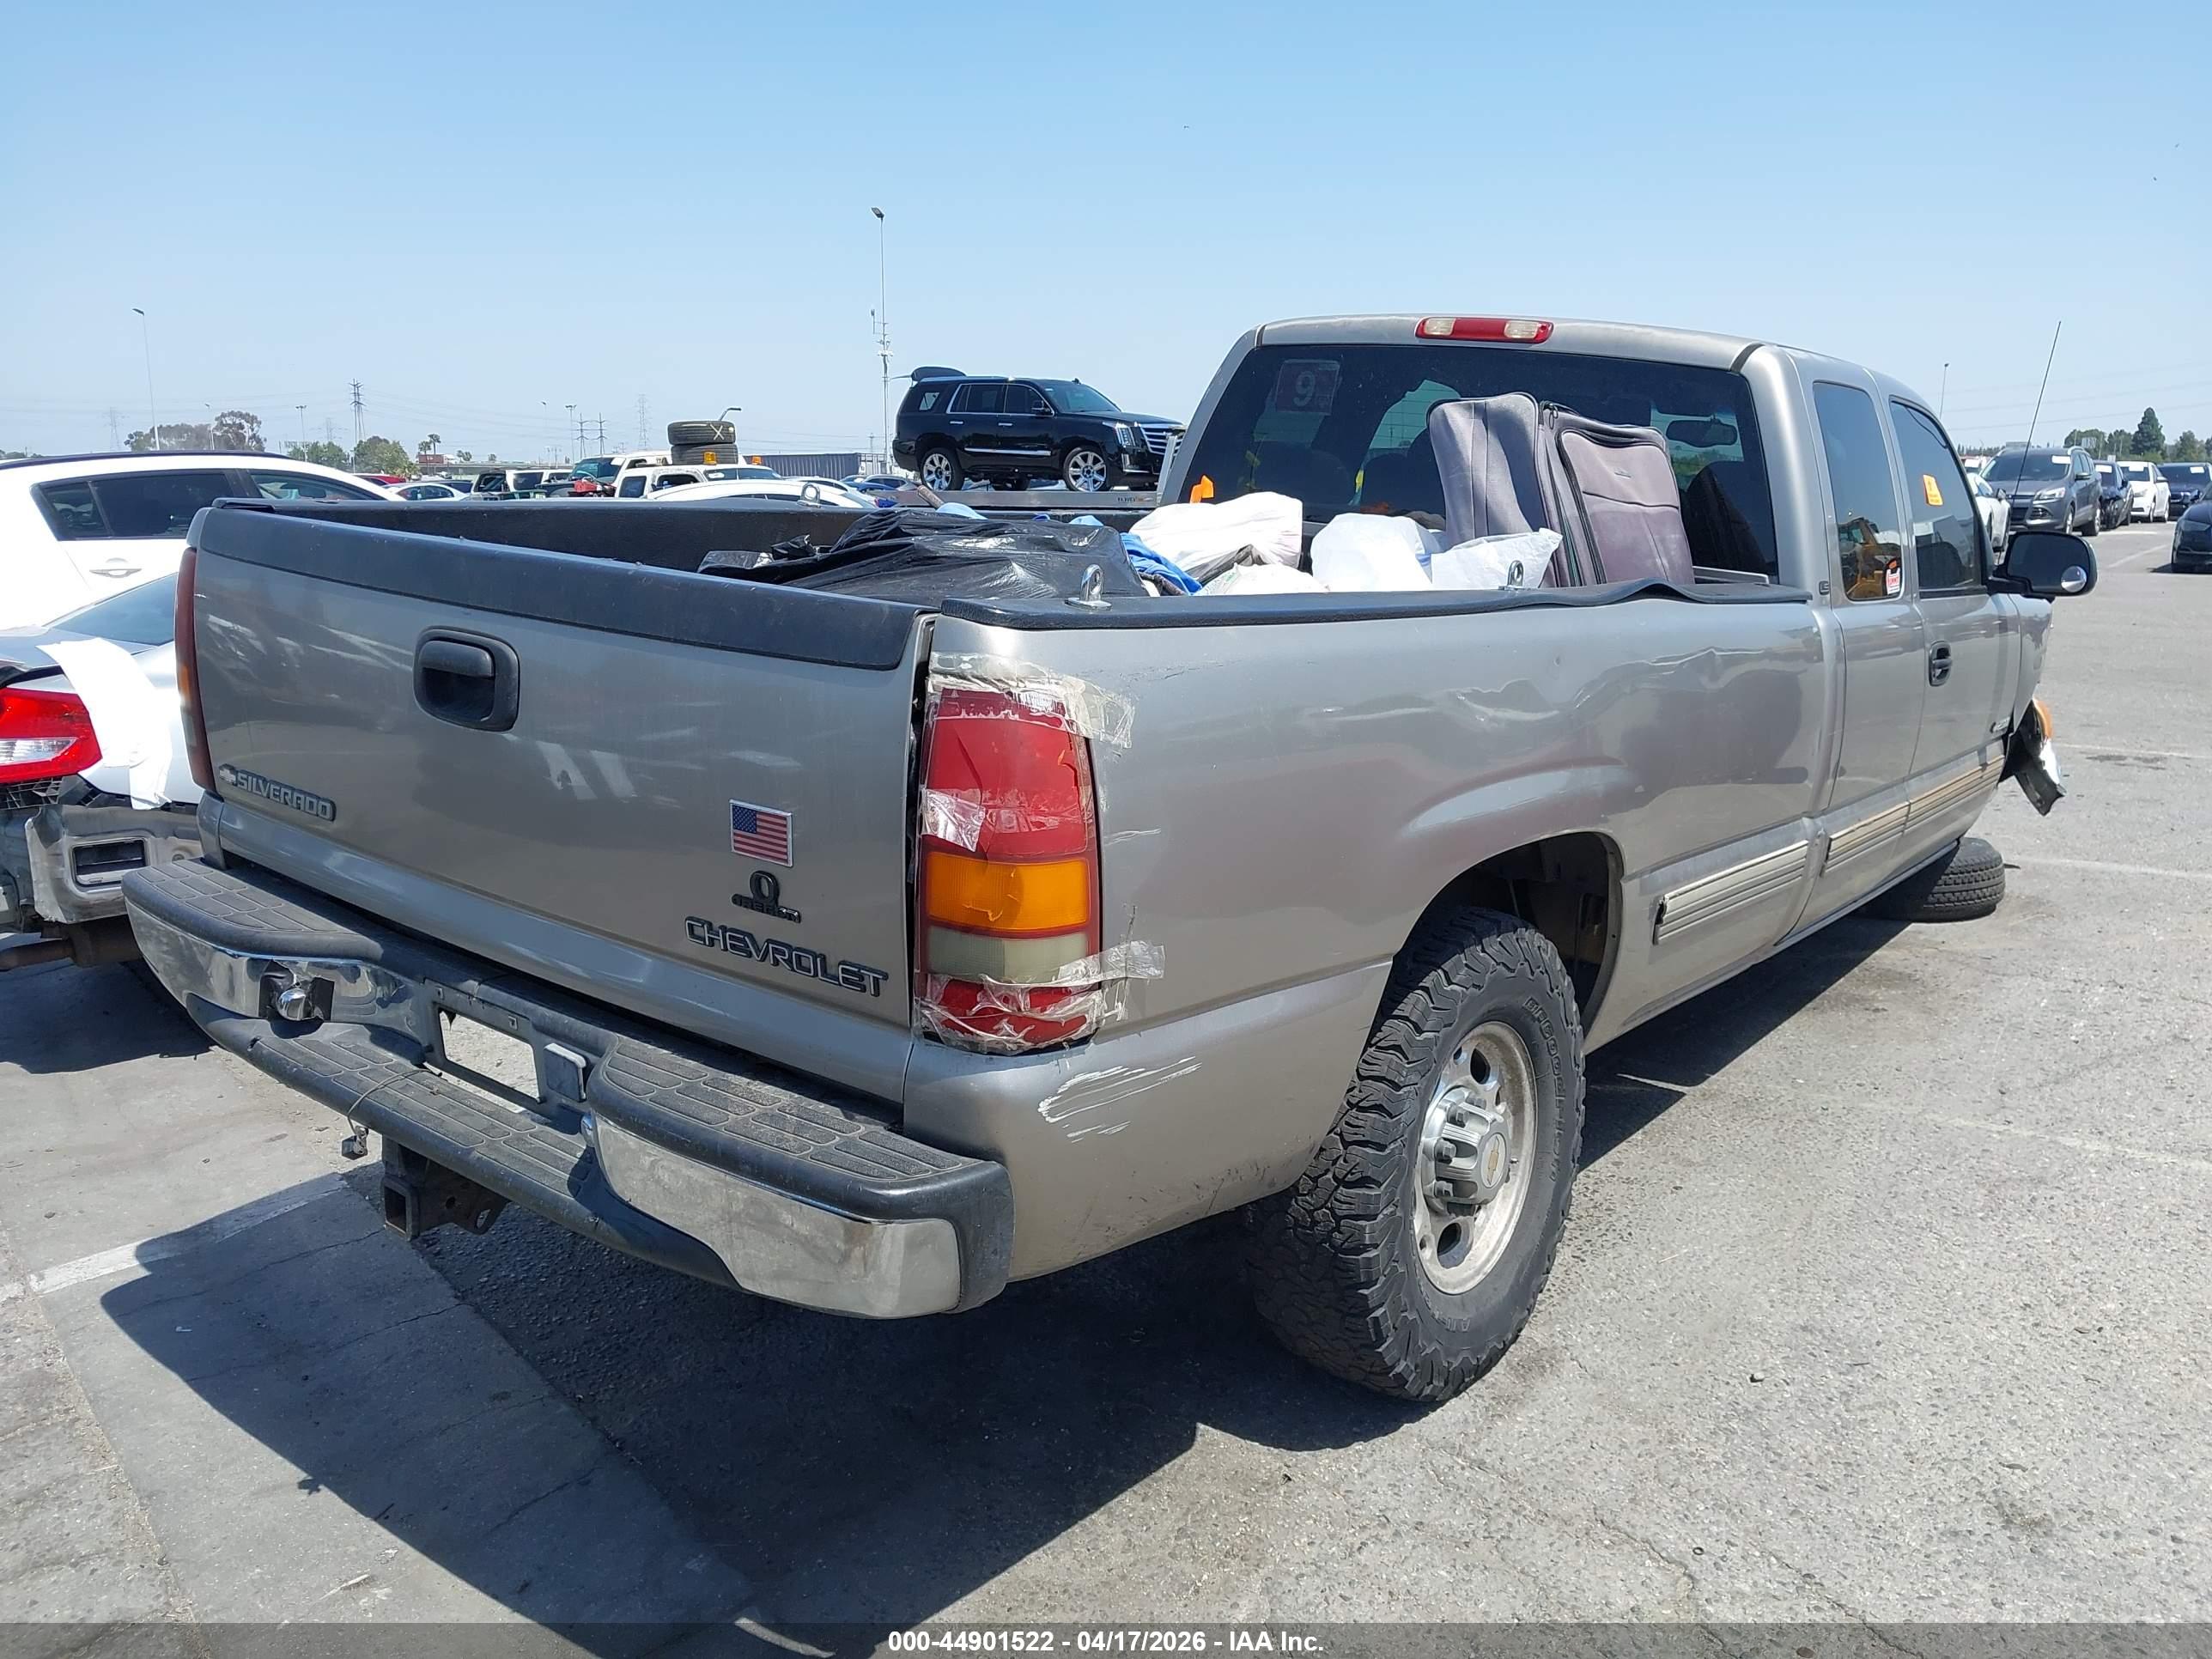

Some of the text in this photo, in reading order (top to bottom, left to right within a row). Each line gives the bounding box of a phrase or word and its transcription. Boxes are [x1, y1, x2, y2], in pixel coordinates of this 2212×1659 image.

[1292, 370, 1316, 407] 9
[237, 771, 332, 820] SILVERADO
[684, 915, 888, 999] CHEVROLET
